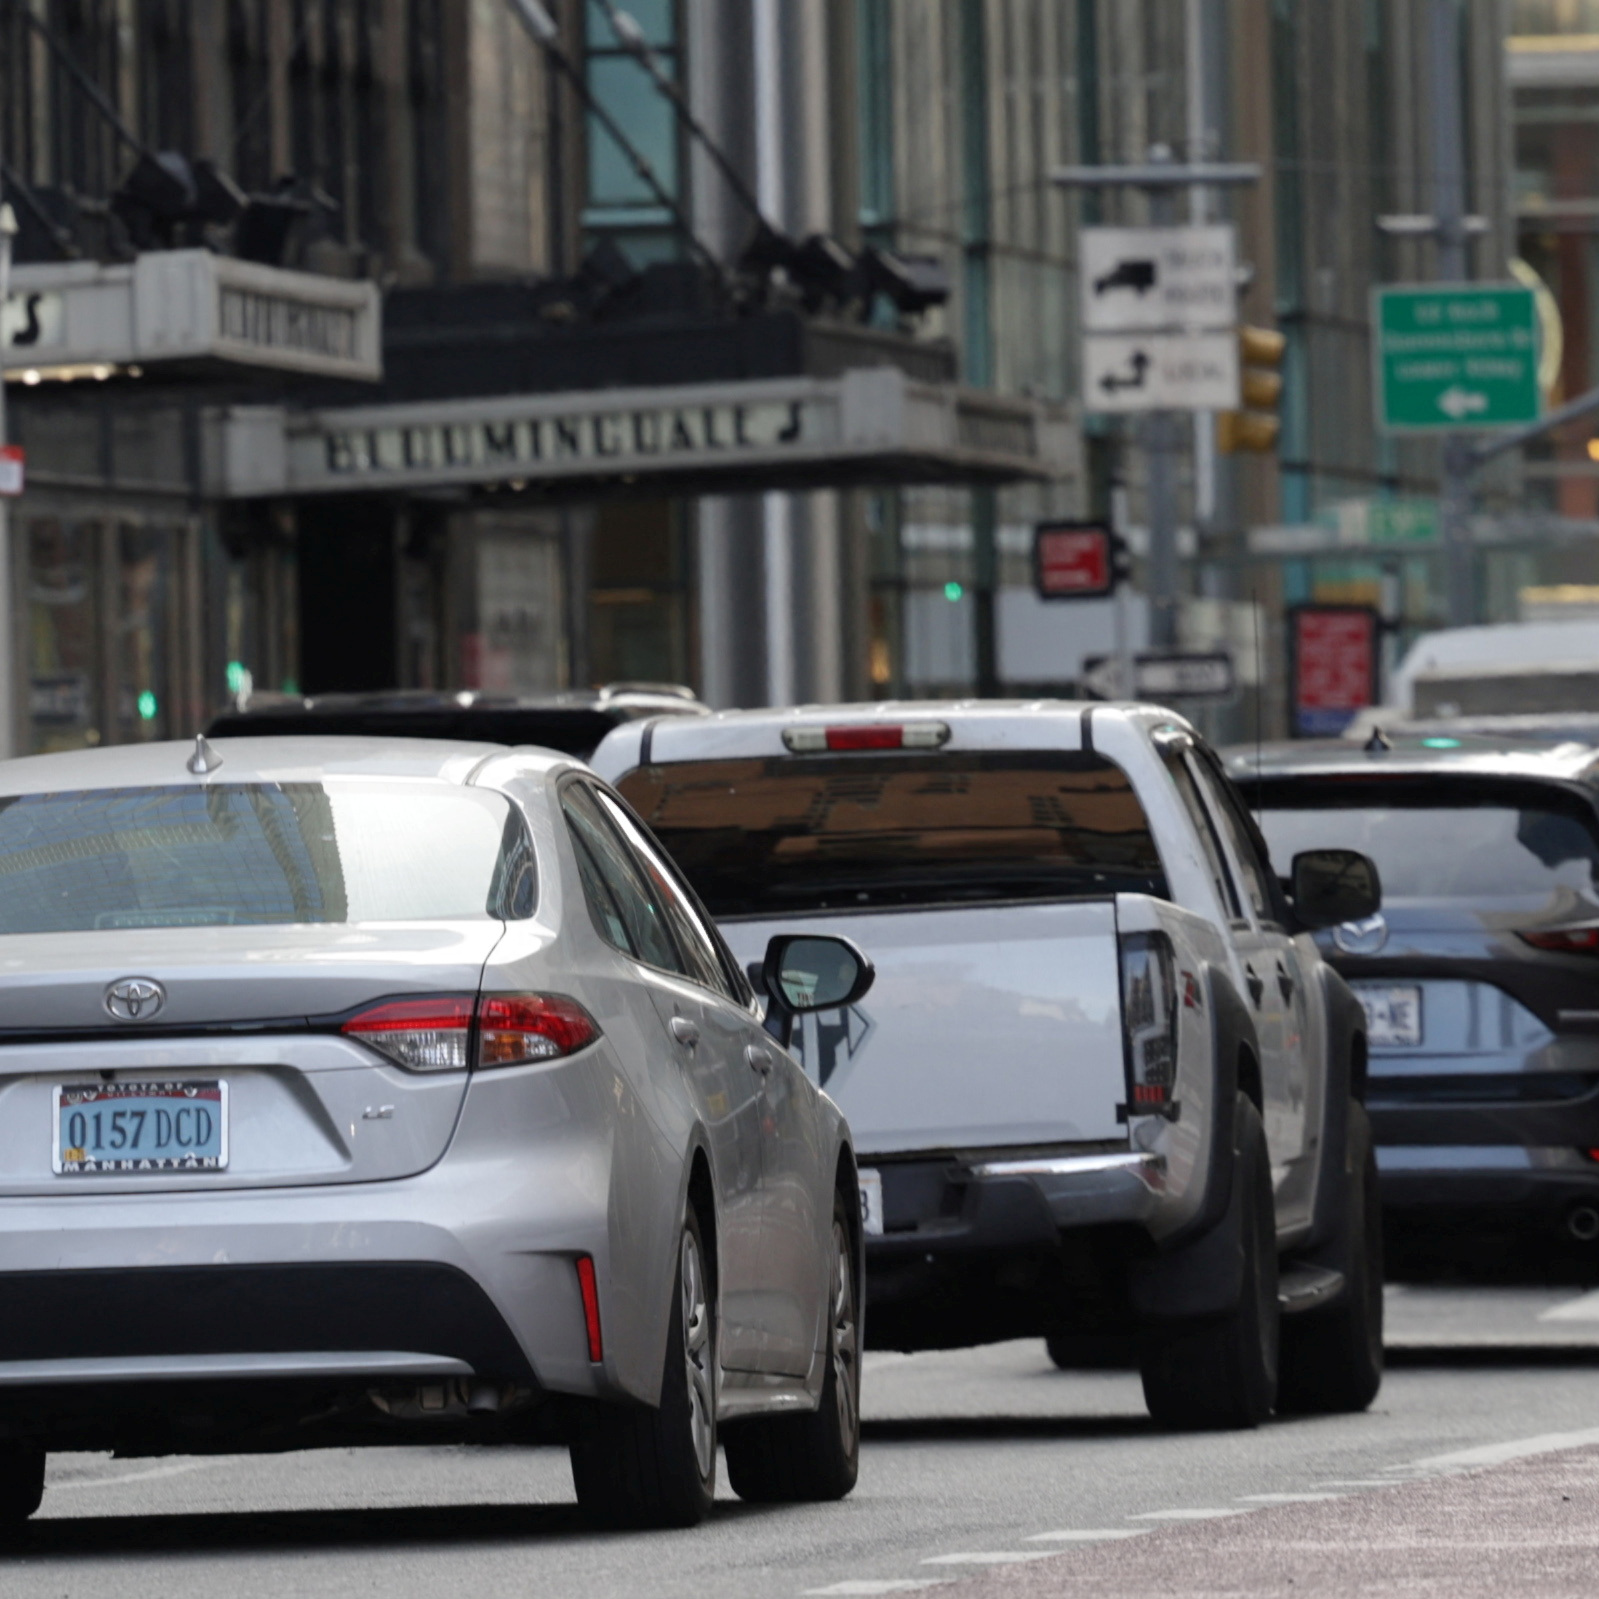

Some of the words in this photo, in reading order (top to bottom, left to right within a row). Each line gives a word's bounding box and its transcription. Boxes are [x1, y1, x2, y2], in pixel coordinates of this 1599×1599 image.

[97, 1082, 158, 1093] TOYOTA
[164, 1082, 184, 1091] OF
[362, 1104, 395, 1120] LE
[68, 1109, 148, 1151] 0157
[155, 1107, 213, 1150] DCD
[63, 1156, 218, 1173] MANHATTAN
